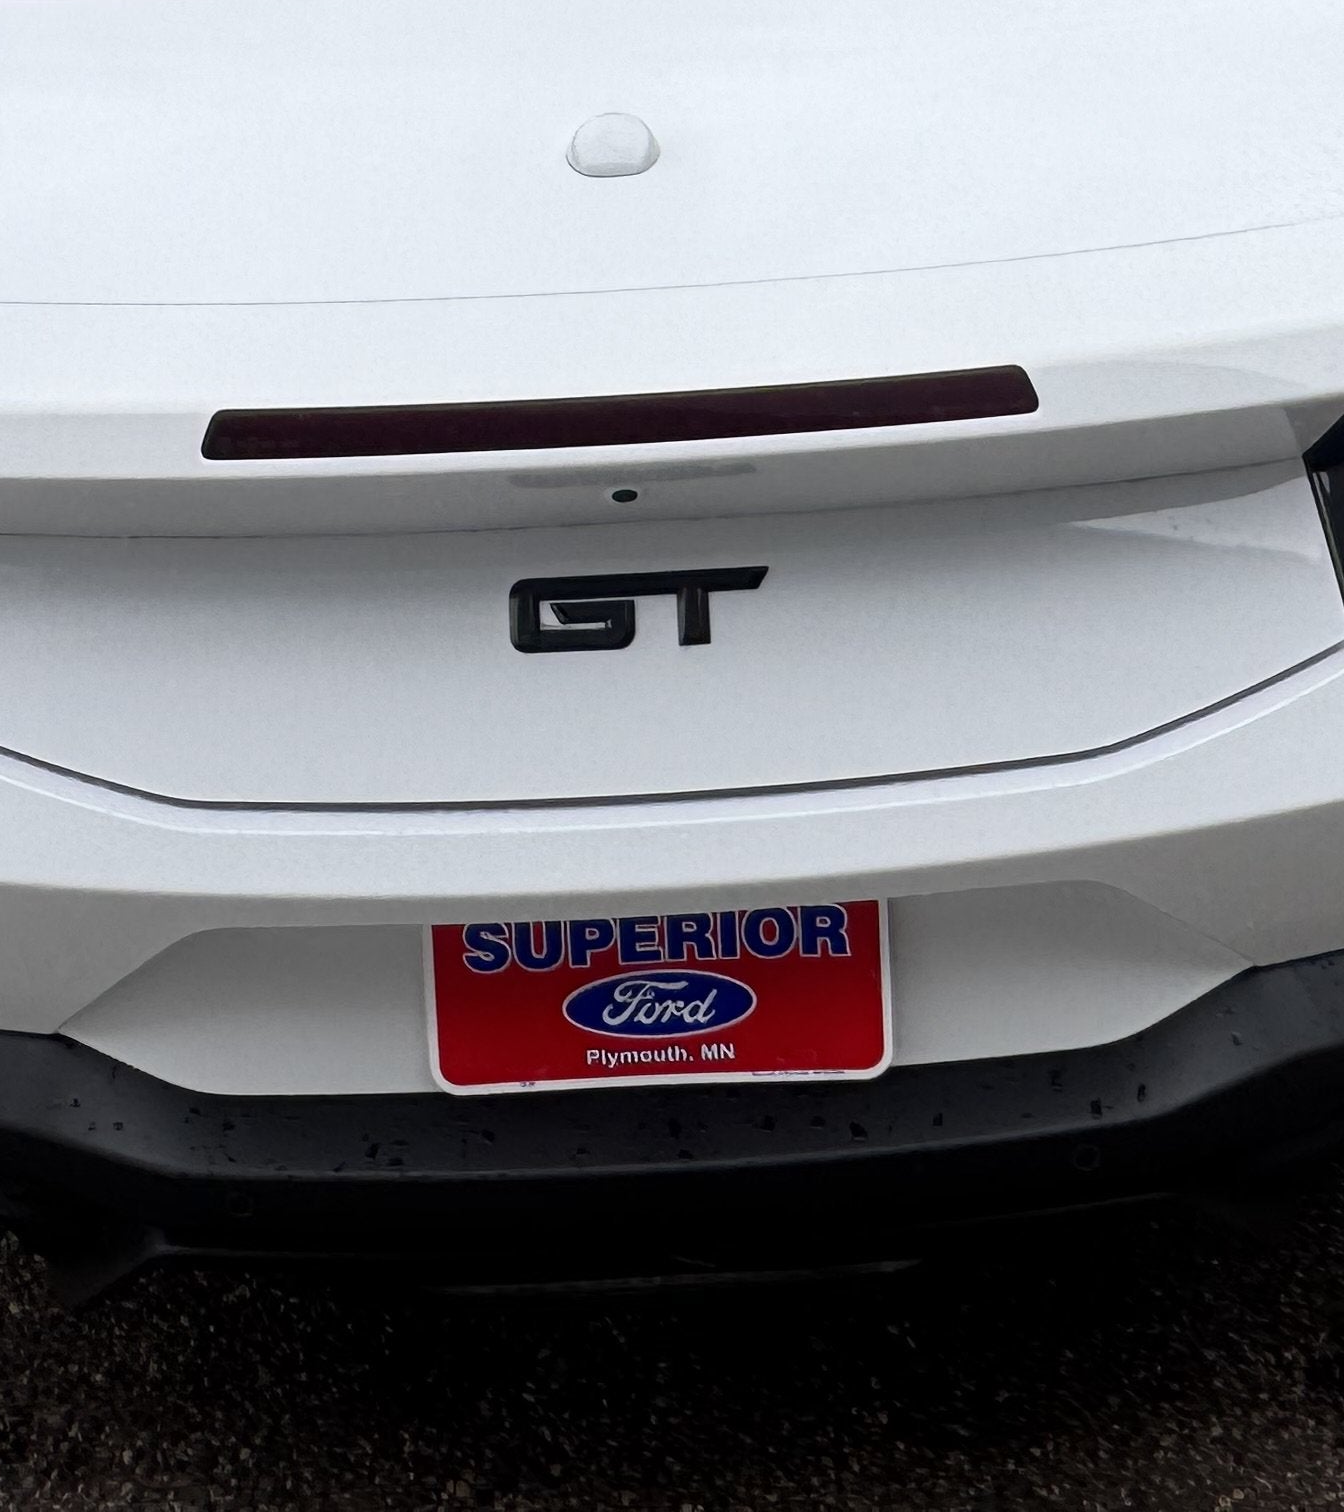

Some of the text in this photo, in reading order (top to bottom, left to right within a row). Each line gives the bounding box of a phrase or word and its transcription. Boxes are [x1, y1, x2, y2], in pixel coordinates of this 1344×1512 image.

[508, 565, 769, 654] GT
[462, 903, 852, 974] SUPERIOR
[601, 978, 718, 1027] Ford
[700, 1042, 736, 1061] MN
